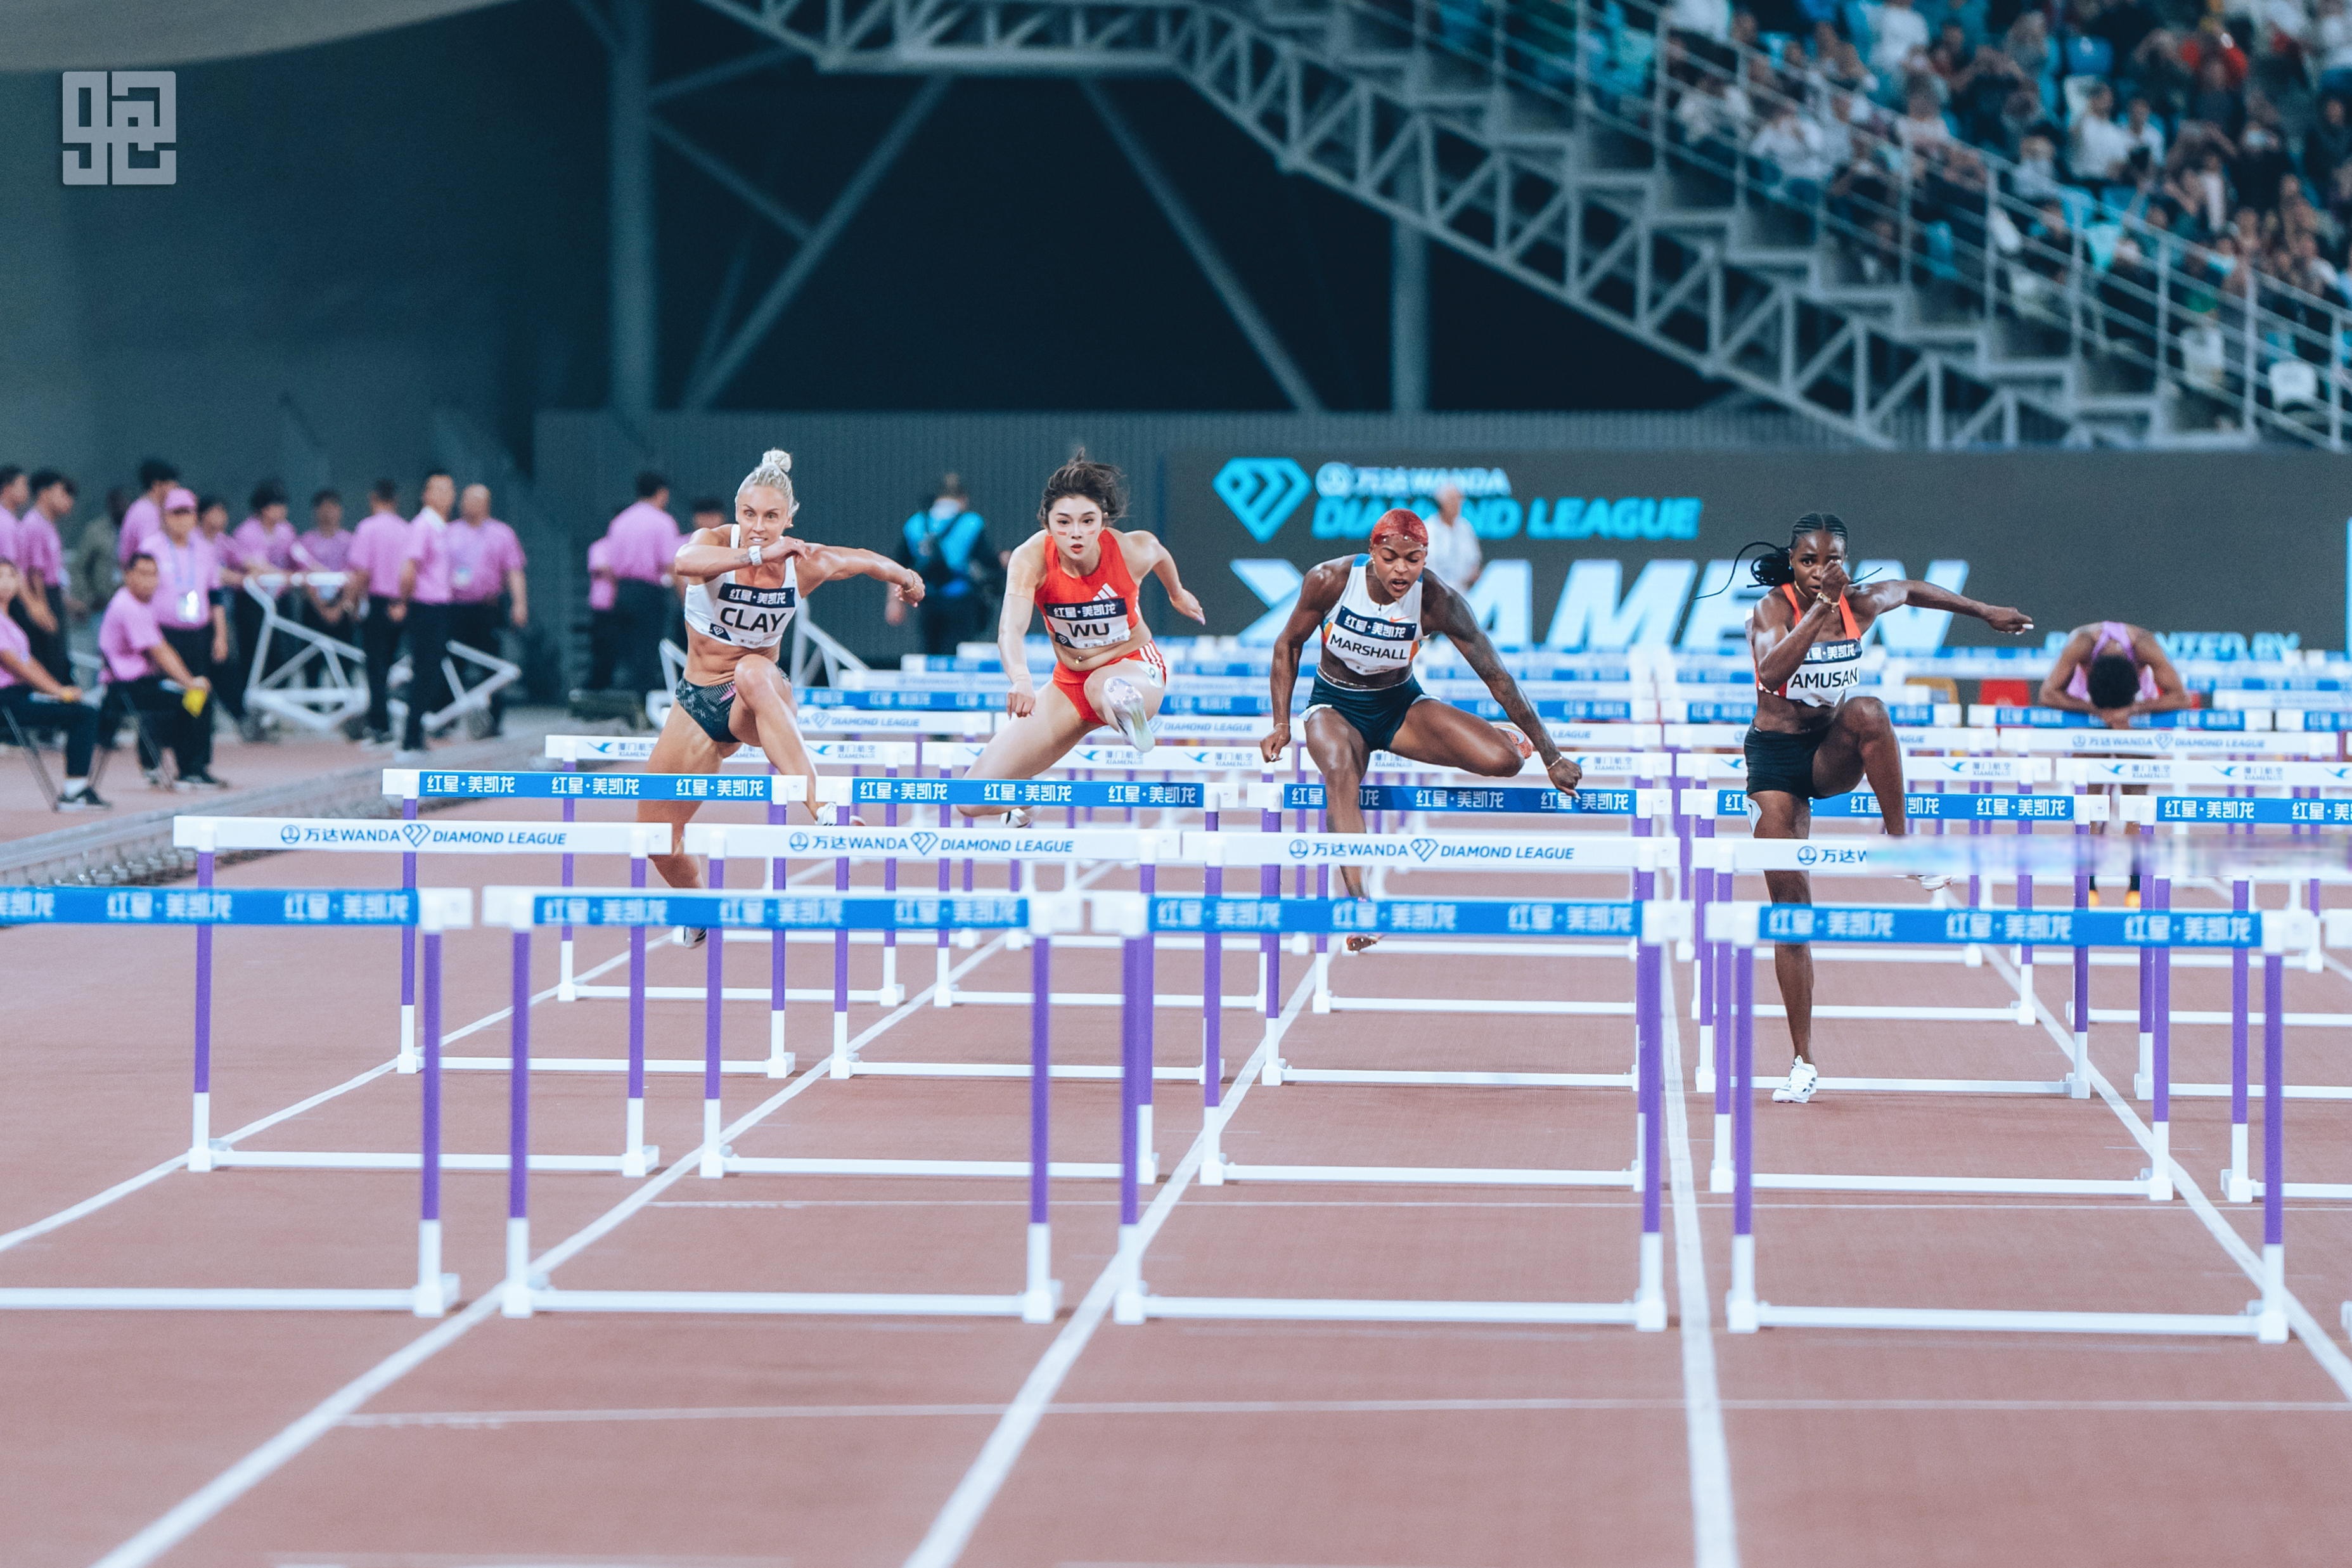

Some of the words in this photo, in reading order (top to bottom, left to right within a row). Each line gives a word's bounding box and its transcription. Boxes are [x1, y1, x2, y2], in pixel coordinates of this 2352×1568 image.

[1526, 497, 1703, 541] LEAGUE
[729, 589, 786, 605] 红星·美凯龙
[1053, 603, 1117, 618] 红星·美凯龙
[720, 607, 787, 633] CLAY
[1344, 615, 1406, 638] 红星·美凯龙
[1066, 623, 1110, 637] WU
[1330, 634, 1408, 660] MARSHALL
[1790, 667, 1858, 688] AMUSAN
[881, 719, 920, 727] LEAGUE
[1164, 723, 1211, 731] DIAMOND
[1214, 723, 1253, 732] LEAGUE
[1552, 730, 1591, 739] LEAGUE
[2175, 738, 2223, 747] DIAMOND
[2226, 739, 2265, 748] LEAGUE
[427, 775, 515, 792] 红星·美凯龙
[552, 777, 639, 795] 红星·美凯龙
[676, 779, 763, 796] 红星·美凯龙
[861, 782, 947, 799] 红星·美凯龙
[985, 784, 1071, 801] 红星·美凯龙
[1109, 786, 1195, 803] 红星·美凯龙
[1417, 790, 1503, 807] 红星·美凯龙
[1977, 799, 2065, 816] 红星·美凯龙
[2165, 800, 2254, 818] 红星·美凯龙
[2292, 802, 2352, 819] 红星·美
[434, 831, 504, 843] DIAMOND
[508, 833, 565, 844] LEAGUE
[941, 839, 1011, 851] DIAMOND
[1015, 840, 1073, 852] LEAGUE
[1441, 845, 1512, 858] DIAMOND
[1516, 847, 1574, 859] LEAGUE
